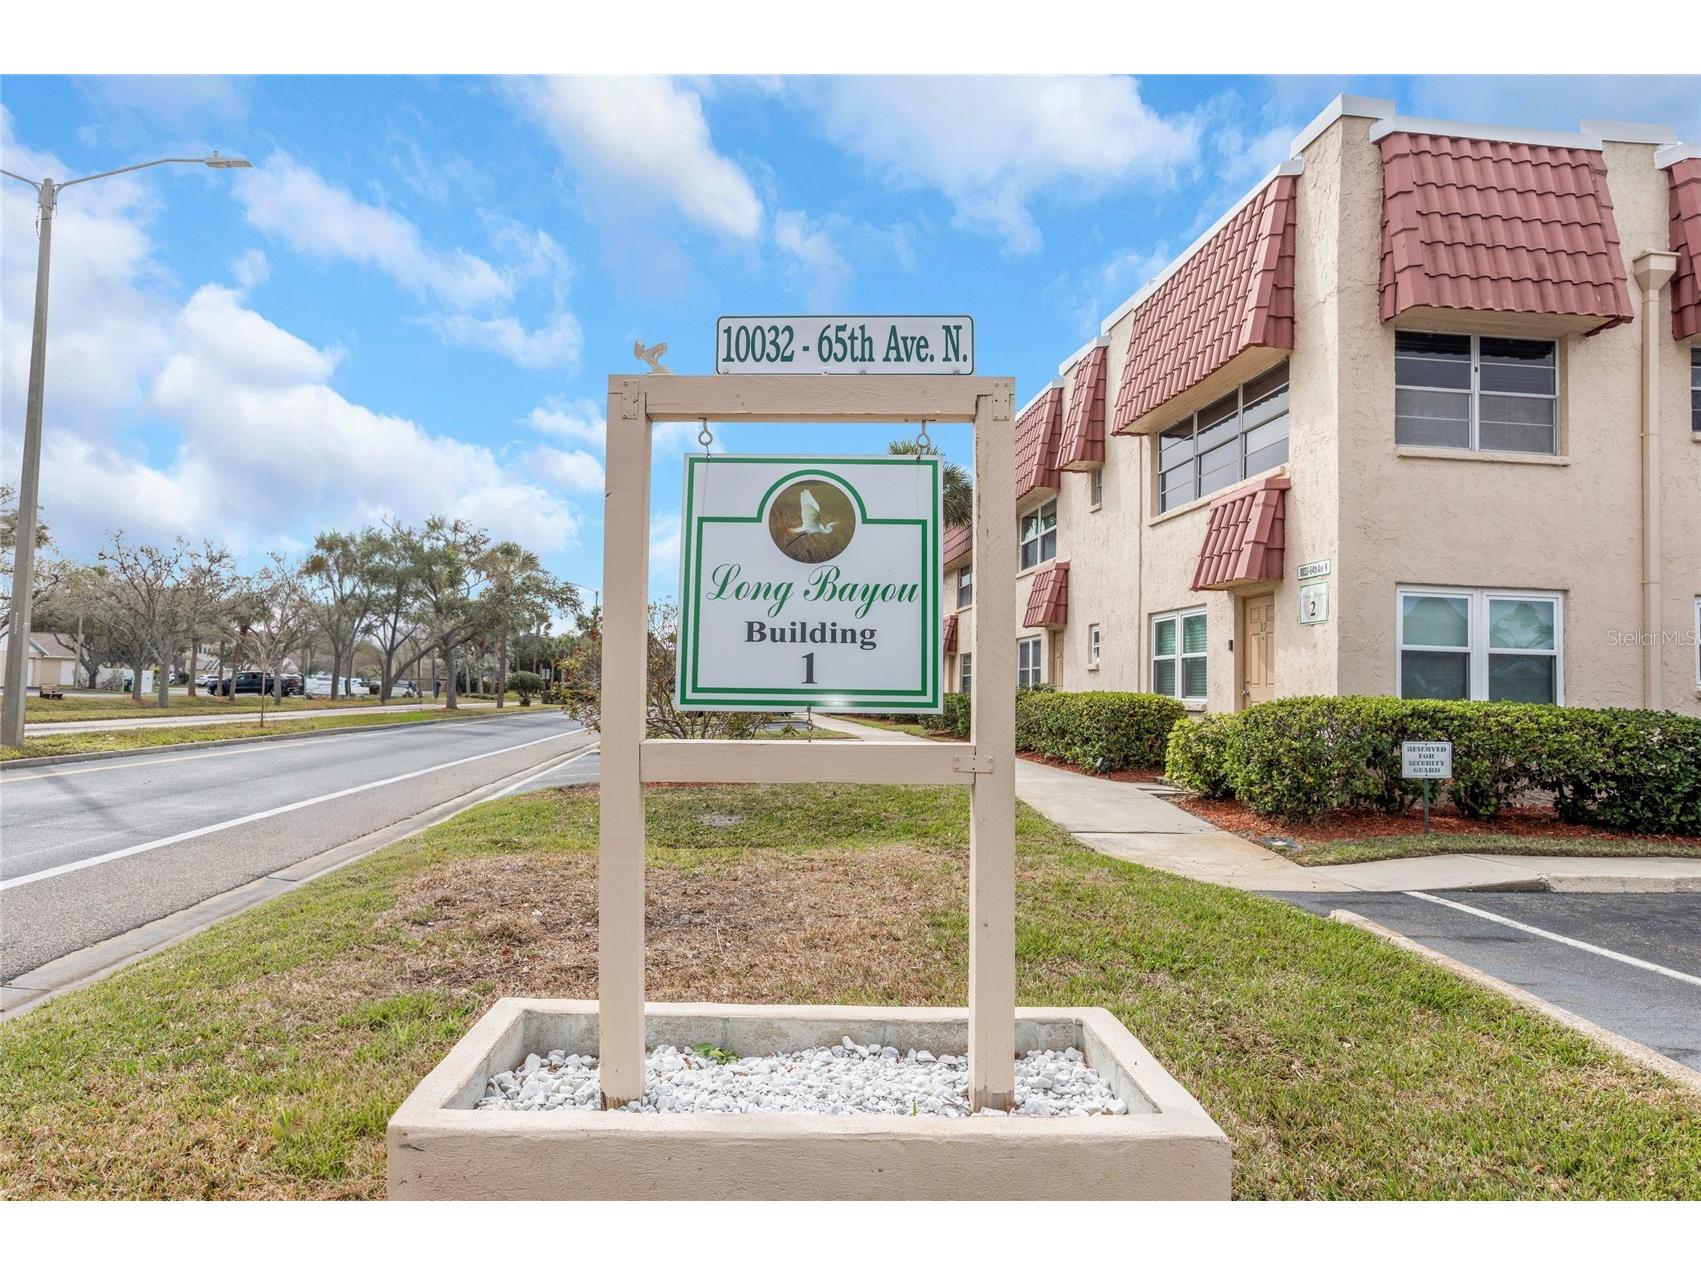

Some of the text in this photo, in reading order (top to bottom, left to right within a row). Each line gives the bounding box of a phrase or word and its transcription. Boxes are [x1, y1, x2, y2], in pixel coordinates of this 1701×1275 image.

[722, 325, 795, 363] 10032
[817, 324, 875, 363] 65th
[882, 325, 935, 363] Ave.
[942, 324, 968, 363] N.
[706, 563, 919, 619] Long Bayou
[1310, 600, 1316, 616] 2
[744, 621, 877, 650] Building
[801, 652, 818, 685] 1
